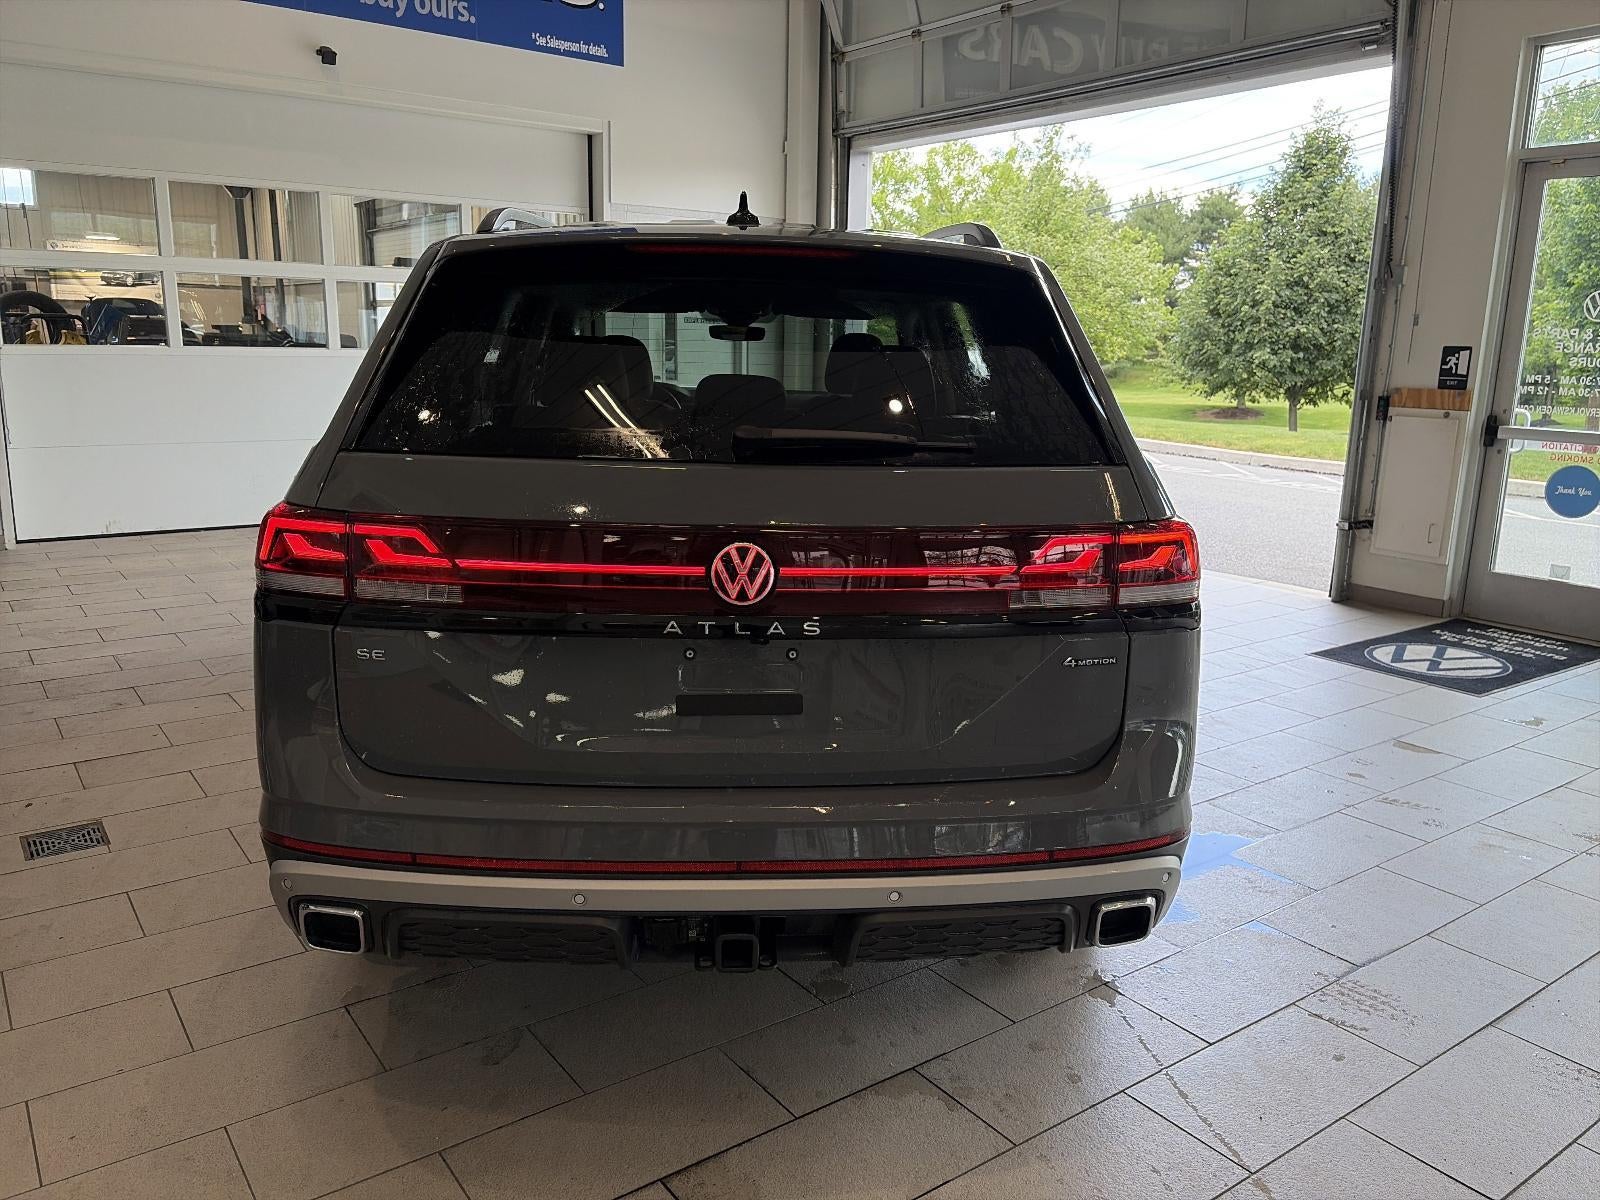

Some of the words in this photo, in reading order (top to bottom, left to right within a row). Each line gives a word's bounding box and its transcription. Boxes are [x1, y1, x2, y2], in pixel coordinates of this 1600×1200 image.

[414, 0, 476, 24] ours.
[547, 35, 580, 52] Salesperson
[580, 41, 588, 54] for
[589, 43, 608, 57] details.
[1555, 485, 1576, 495] Thank
[1578, 487, 1592, 497] You
[663, 620, 821, 636] ATLAS
[356, 648, 386, 661] SE
[1063, 656, 1116, 668] 4MOTION
